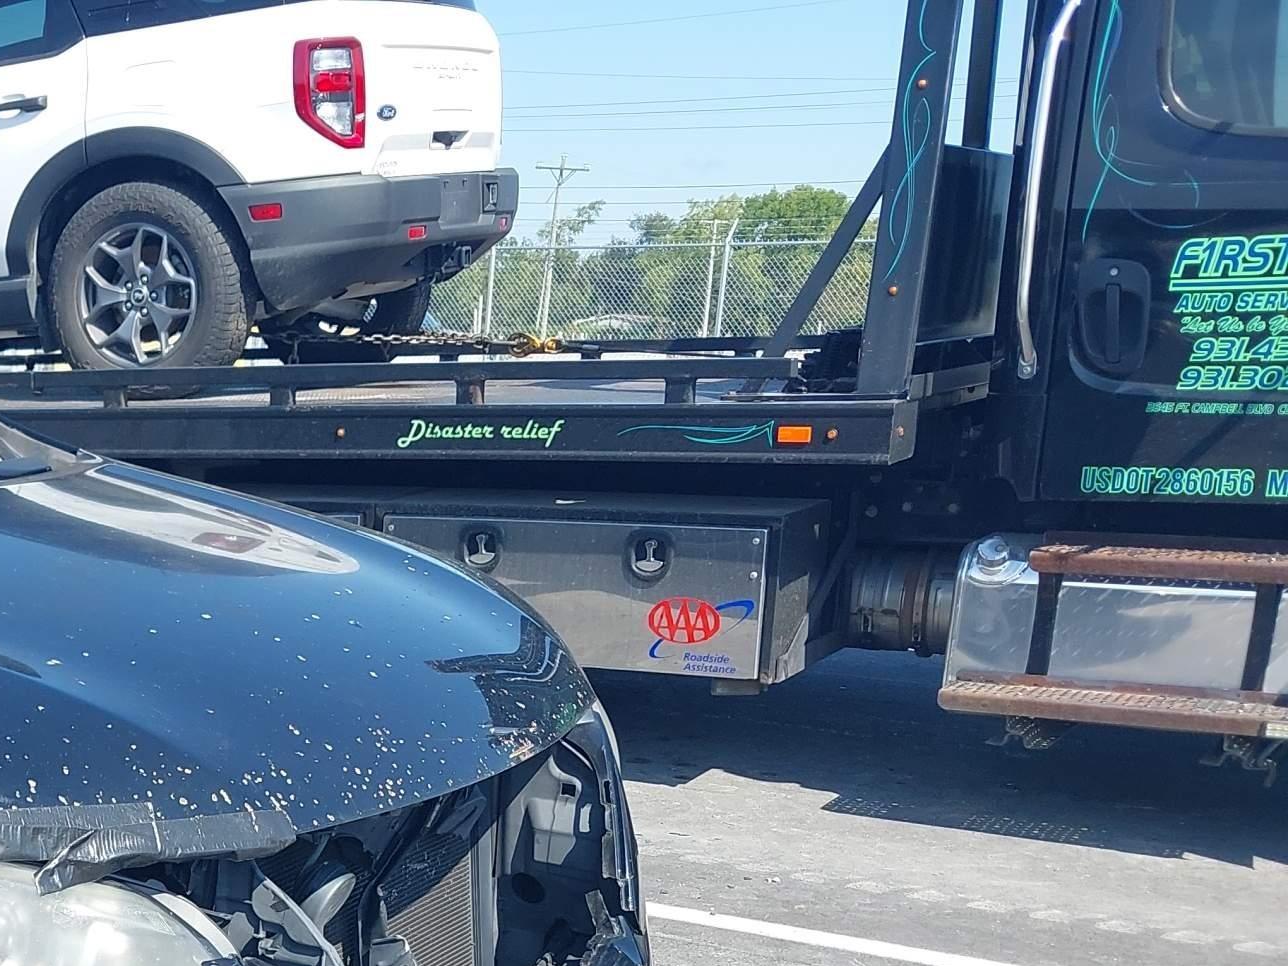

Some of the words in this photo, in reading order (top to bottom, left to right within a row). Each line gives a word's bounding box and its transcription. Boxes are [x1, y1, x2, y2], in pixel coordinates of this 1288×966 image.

[1173, 292, 1234, 313] AUTO
[1192, 403, 1244, 414] CAMPBELL
[397, 419, 494, 448] Disaster
[500, 419, 565, 448] relief
[650, 597, 719, 643] AAA
[683, 652, 730, 664] Roadside
[683, 663, 737, 674] Assistance
